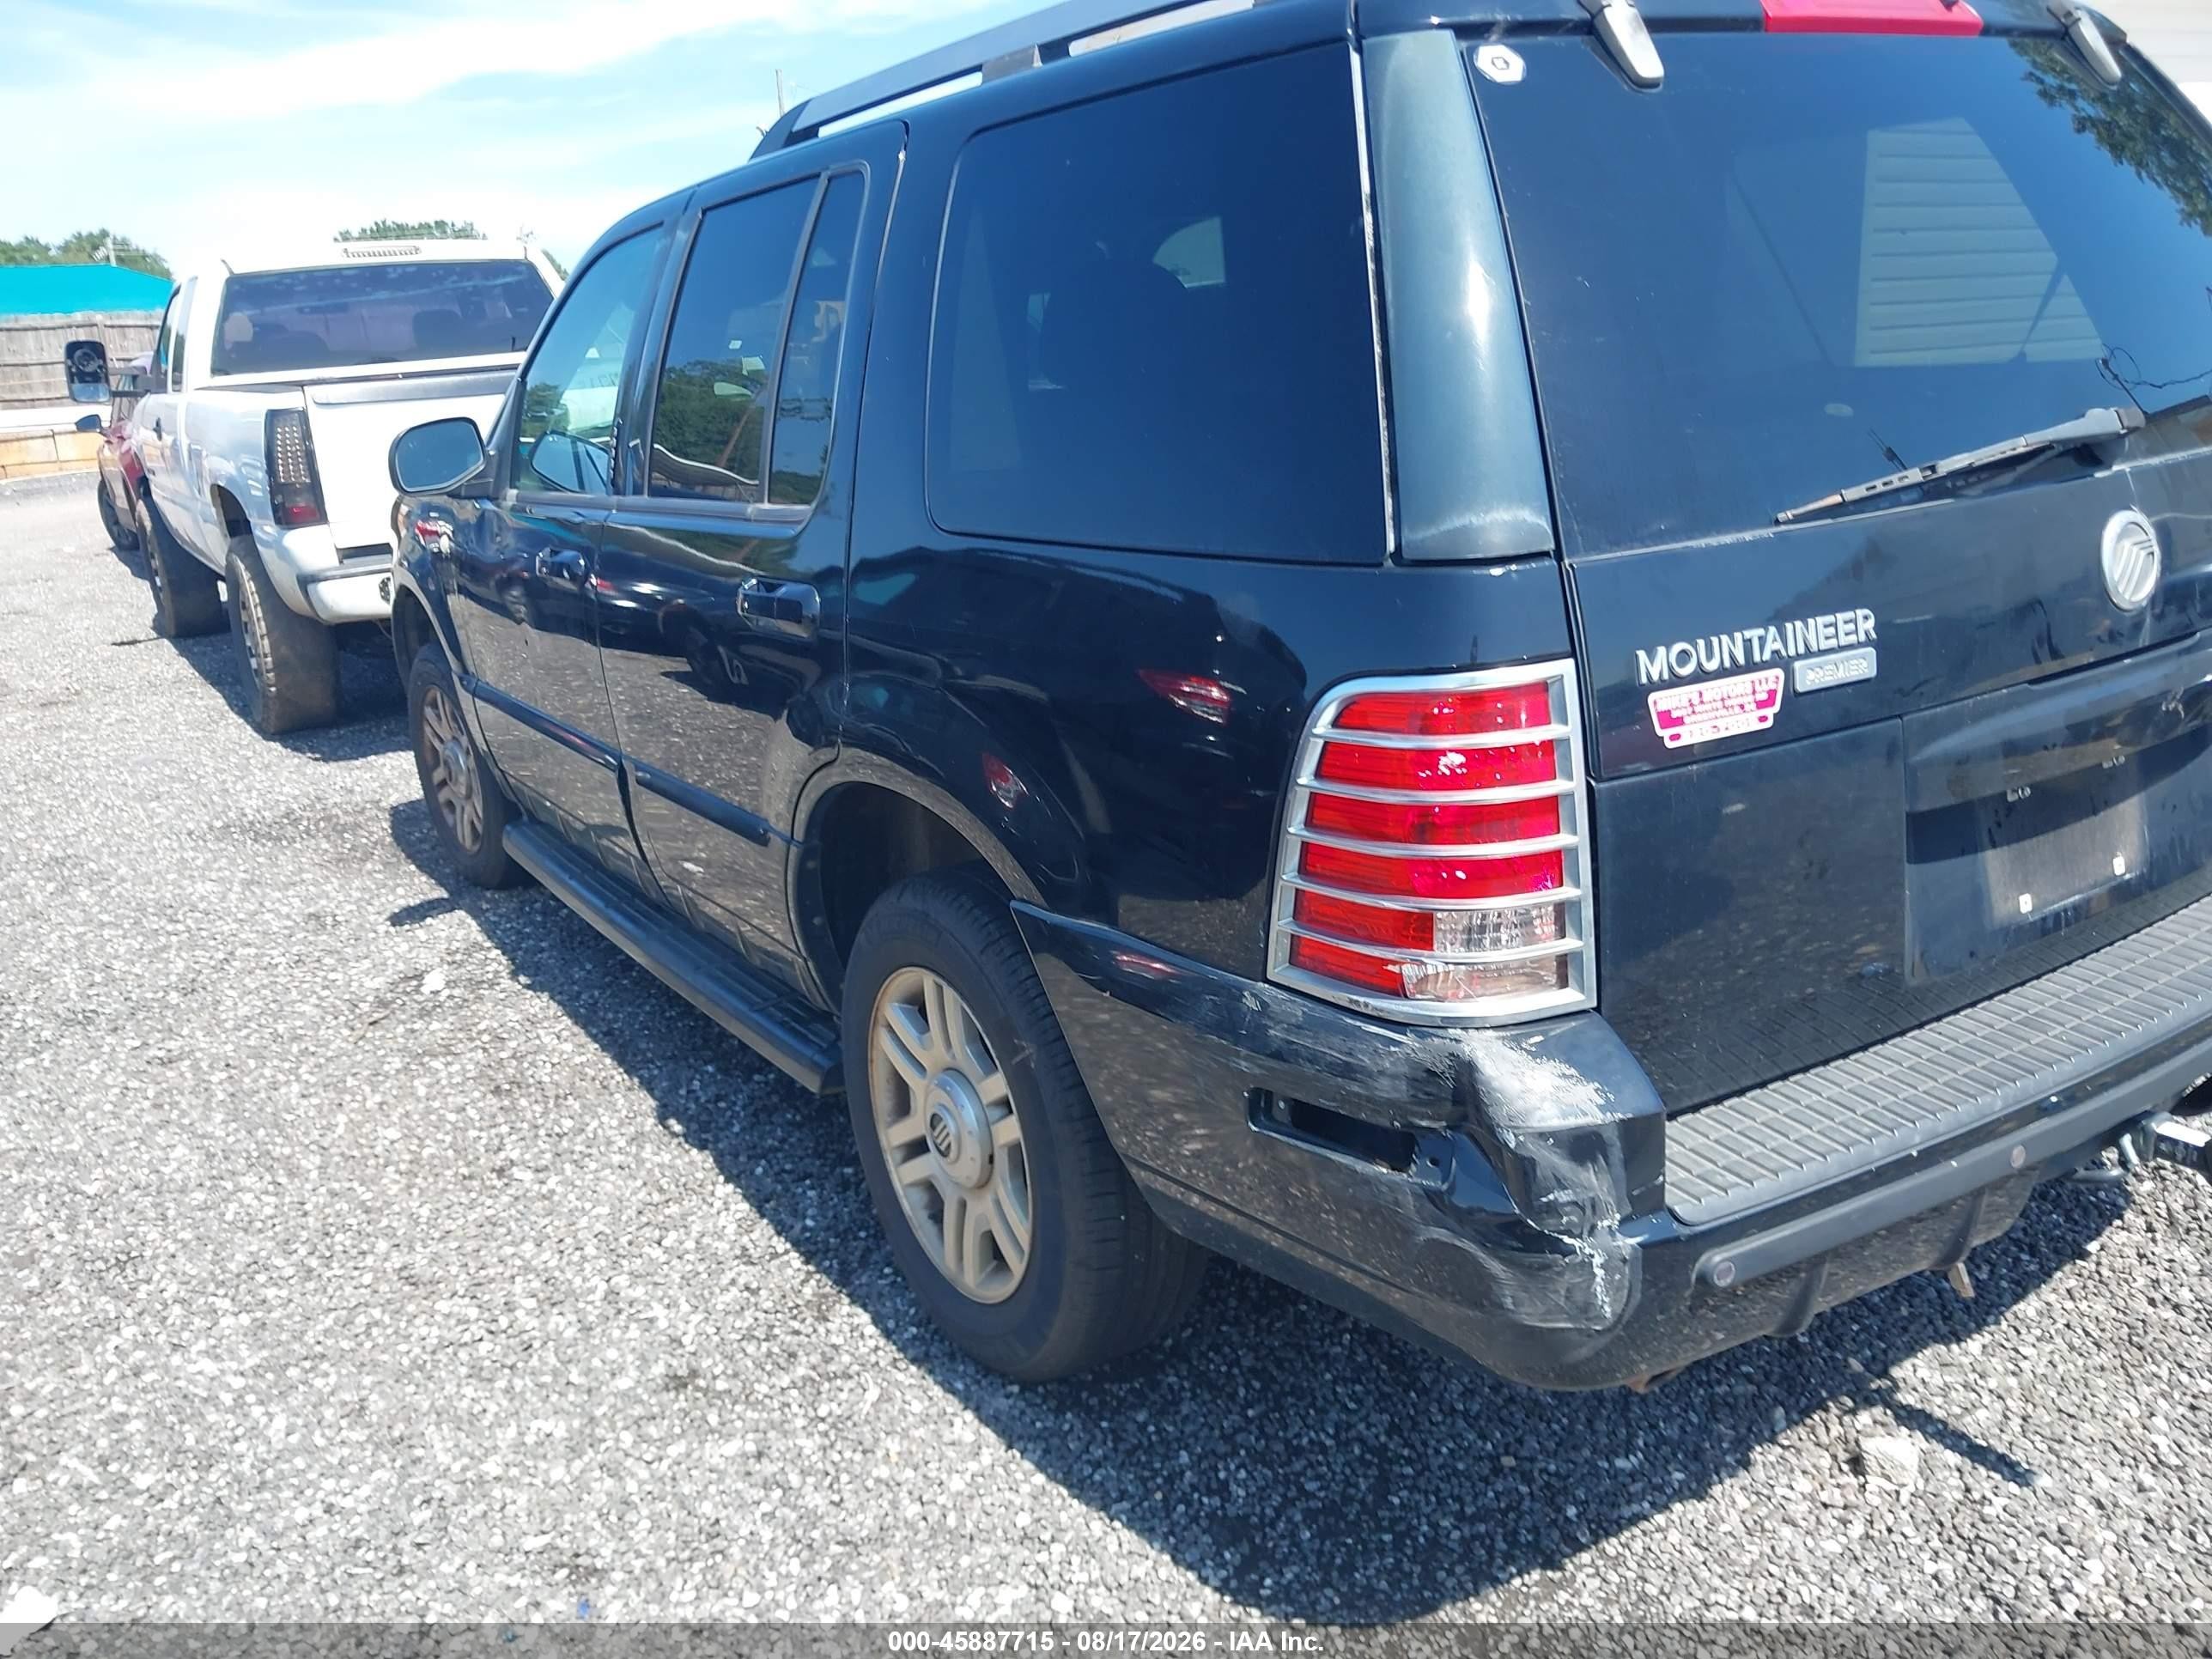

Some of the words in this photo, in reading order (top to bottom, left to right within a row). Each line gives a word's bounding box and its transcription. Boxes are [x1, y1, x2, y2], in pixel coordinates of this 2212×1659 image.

[1635, 608, 1878, 685] MOUNTAINEER
[1805, 657, 1869, 685] PREMIER
[1703, 679, 1753, 703] MOTORS
